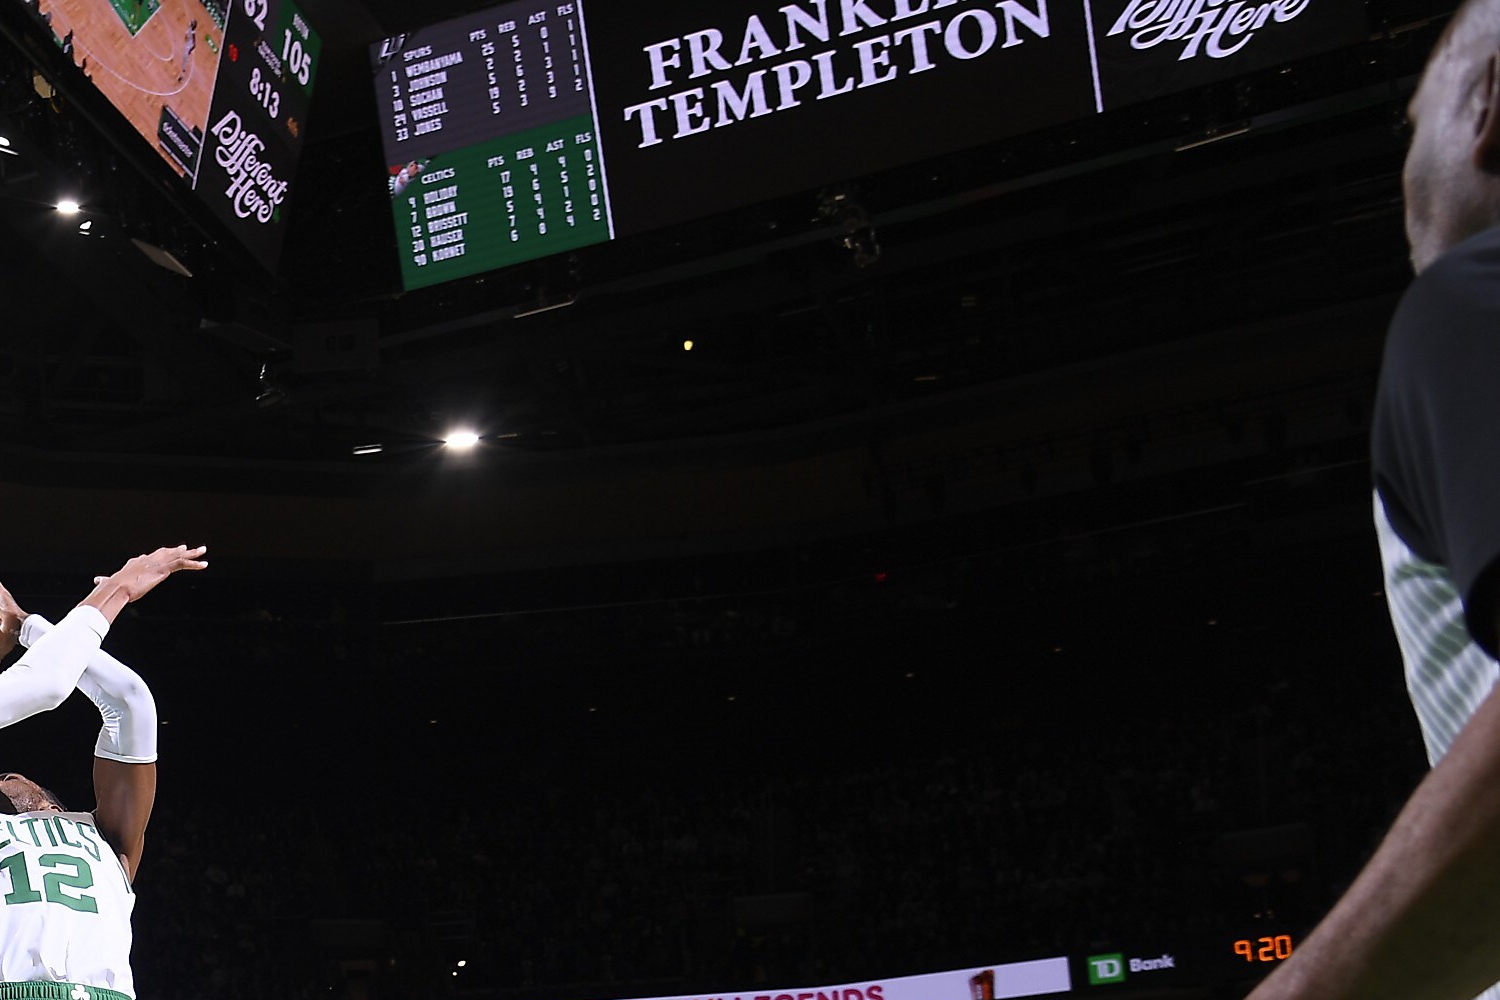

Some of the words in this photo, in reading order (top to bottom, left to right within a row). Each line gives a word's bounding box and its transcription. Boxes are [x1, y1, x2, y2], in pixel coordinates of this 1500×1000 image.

[470, 29, 487, 43] PTS
[498, 21, 516, 35] REB
[528, 11, 546, 25] AST
[557, 4, 574, 17] FLS
[481, 42, 495, 56] 25
[512, 35, 520, 47] 5
[567, 19, 573, 31] 1
[282, 28, 312, 86] 105
[403, 45, 433, 62] SPURS
[642, 0, 968, 91] FRANK
[392, 86, 400, 97] 3
[486, 58, 494, 70] 2
[514, 50, 522, 62] 2
[543, 41, 549, 53] 1
[569, 34, 575, 46] 1
[488, 72, 496, 85] 5
[516, 64, 523, 77] 6
[545, 56, 553, 68] 3
[572, 49, 578, 61] 1
[518, 79, 526, 92] 2
[546, 71, 554, 83] 3
[574, 64, 580, 76] 1
[623, 0, 1051, 149] TEMPLETON
[249, 67, 280, 118] 8:13
[492, 102, 501, 114] 5
[520, 94, 528, 107] 3
[575, 78, 583, 91] 2
[211, 110, 288, 204] Different
[487, 156, 505, 168] PTS
[516, 147, 534, 160] REB
[545, 139, 565, 152] AST
[575, 132, 592, 145] FLS
[500, 170, 511, 184] 17
[584, 149, 592, 161] 0
[410, 211, 417, 223] 7
[532, 178, 540, 191] 6
[560, 170, 568, 183] 5
[586, 163, 595, 176] 2
[421, 167, 455, 184] CELTICS
[225, 167, 274, 223] Here
[411, 225, 422, 238] 12
[506, 200, 514, 213] 5
[563, 185, 569, 197] 1
[588, 178, 596, 191] 0
[508, 215, 516, 227] 7
[564, 200, 573, 213] 2
[590, 193, 598, 206] 0
[510, 229, 518, 241] 6
[592, 208, 601, 221] 2
[0, 851, 99, 914] 12
[1091, 958, 1122, 978] TD
[1129, 954, 1175, 972] Bank
